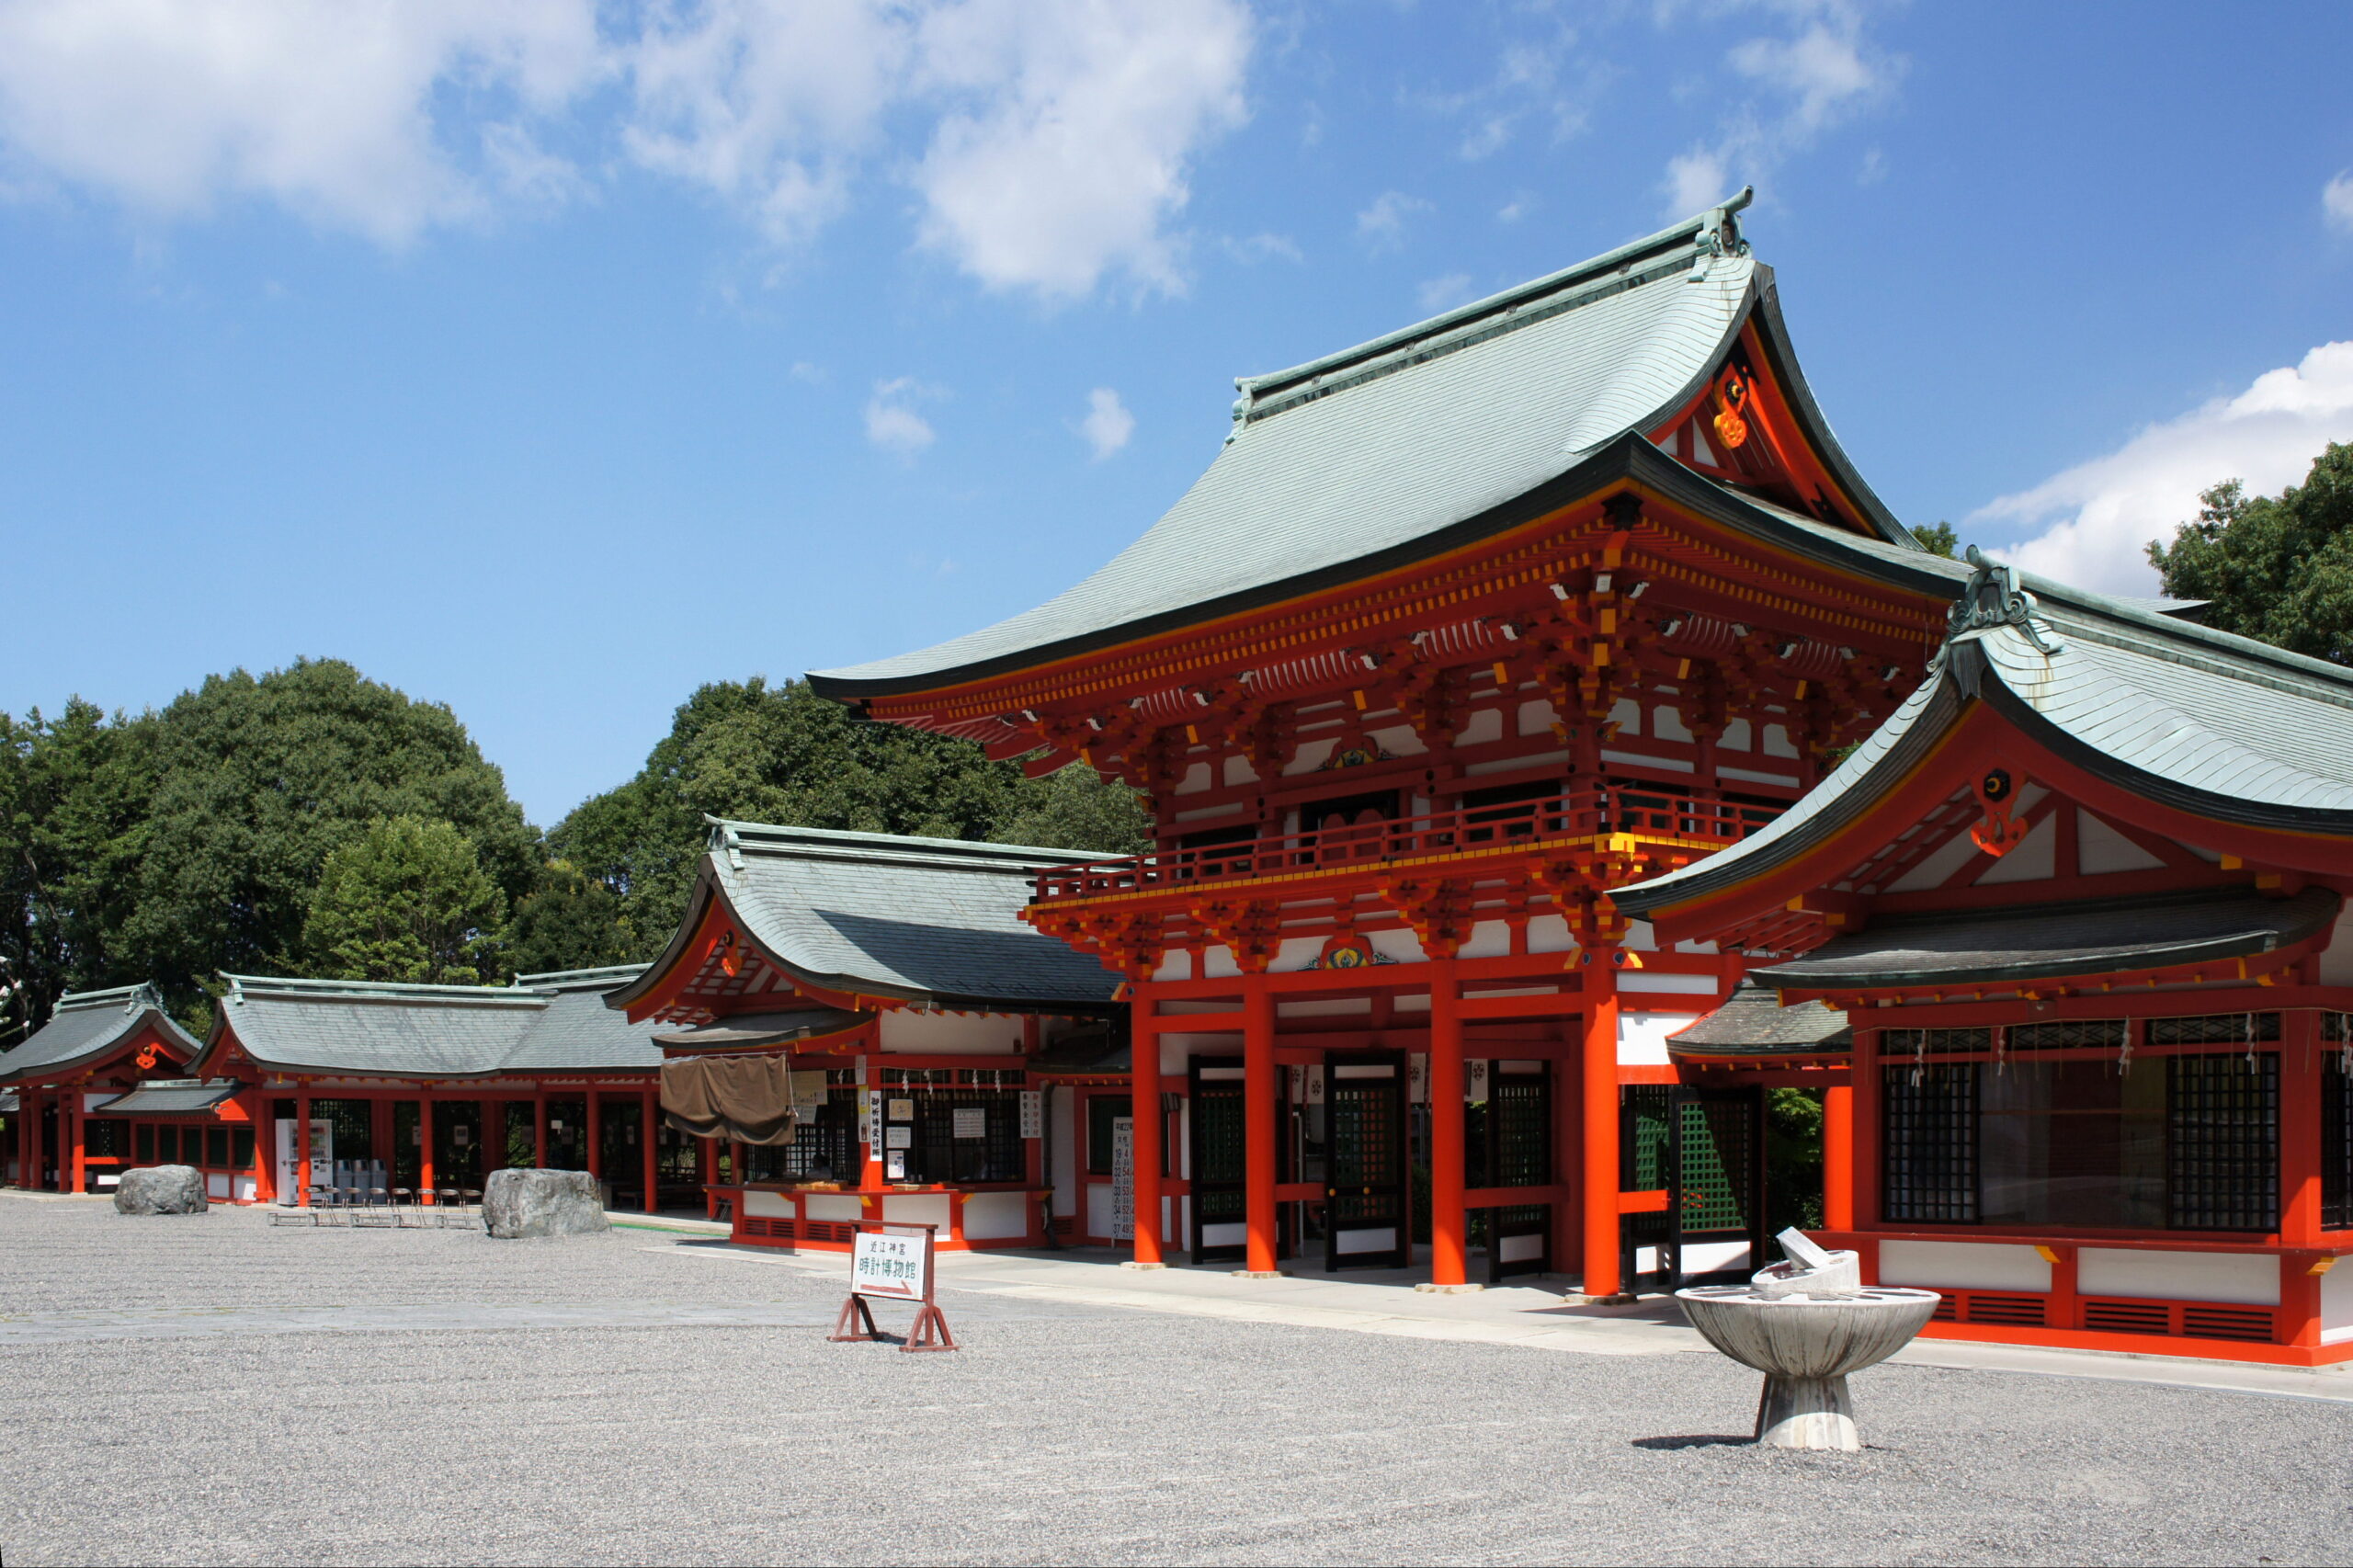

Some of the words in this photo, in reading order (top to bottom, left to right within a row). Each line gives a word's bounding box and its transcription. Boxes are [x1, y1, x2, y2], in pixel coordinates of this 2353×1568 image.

[1114, 1166, 1121, 1177] 32
[1122, 1167, 1130, 1176] 54
[1113, 1186, 1121, 1196] 33
[1122, 1186, 1130, 1196] 53
[1113, 1204, 1121, 1215] 34
[1122, 1204, 1130, 1215] 52
[1113, 1223, 1120, 1234] 37
[1121, 1223, 1130, 1233] 49
[870, 1240, 906, 1256] 近江神宮
[858, 1257, 916, 1279] 時計博物館
